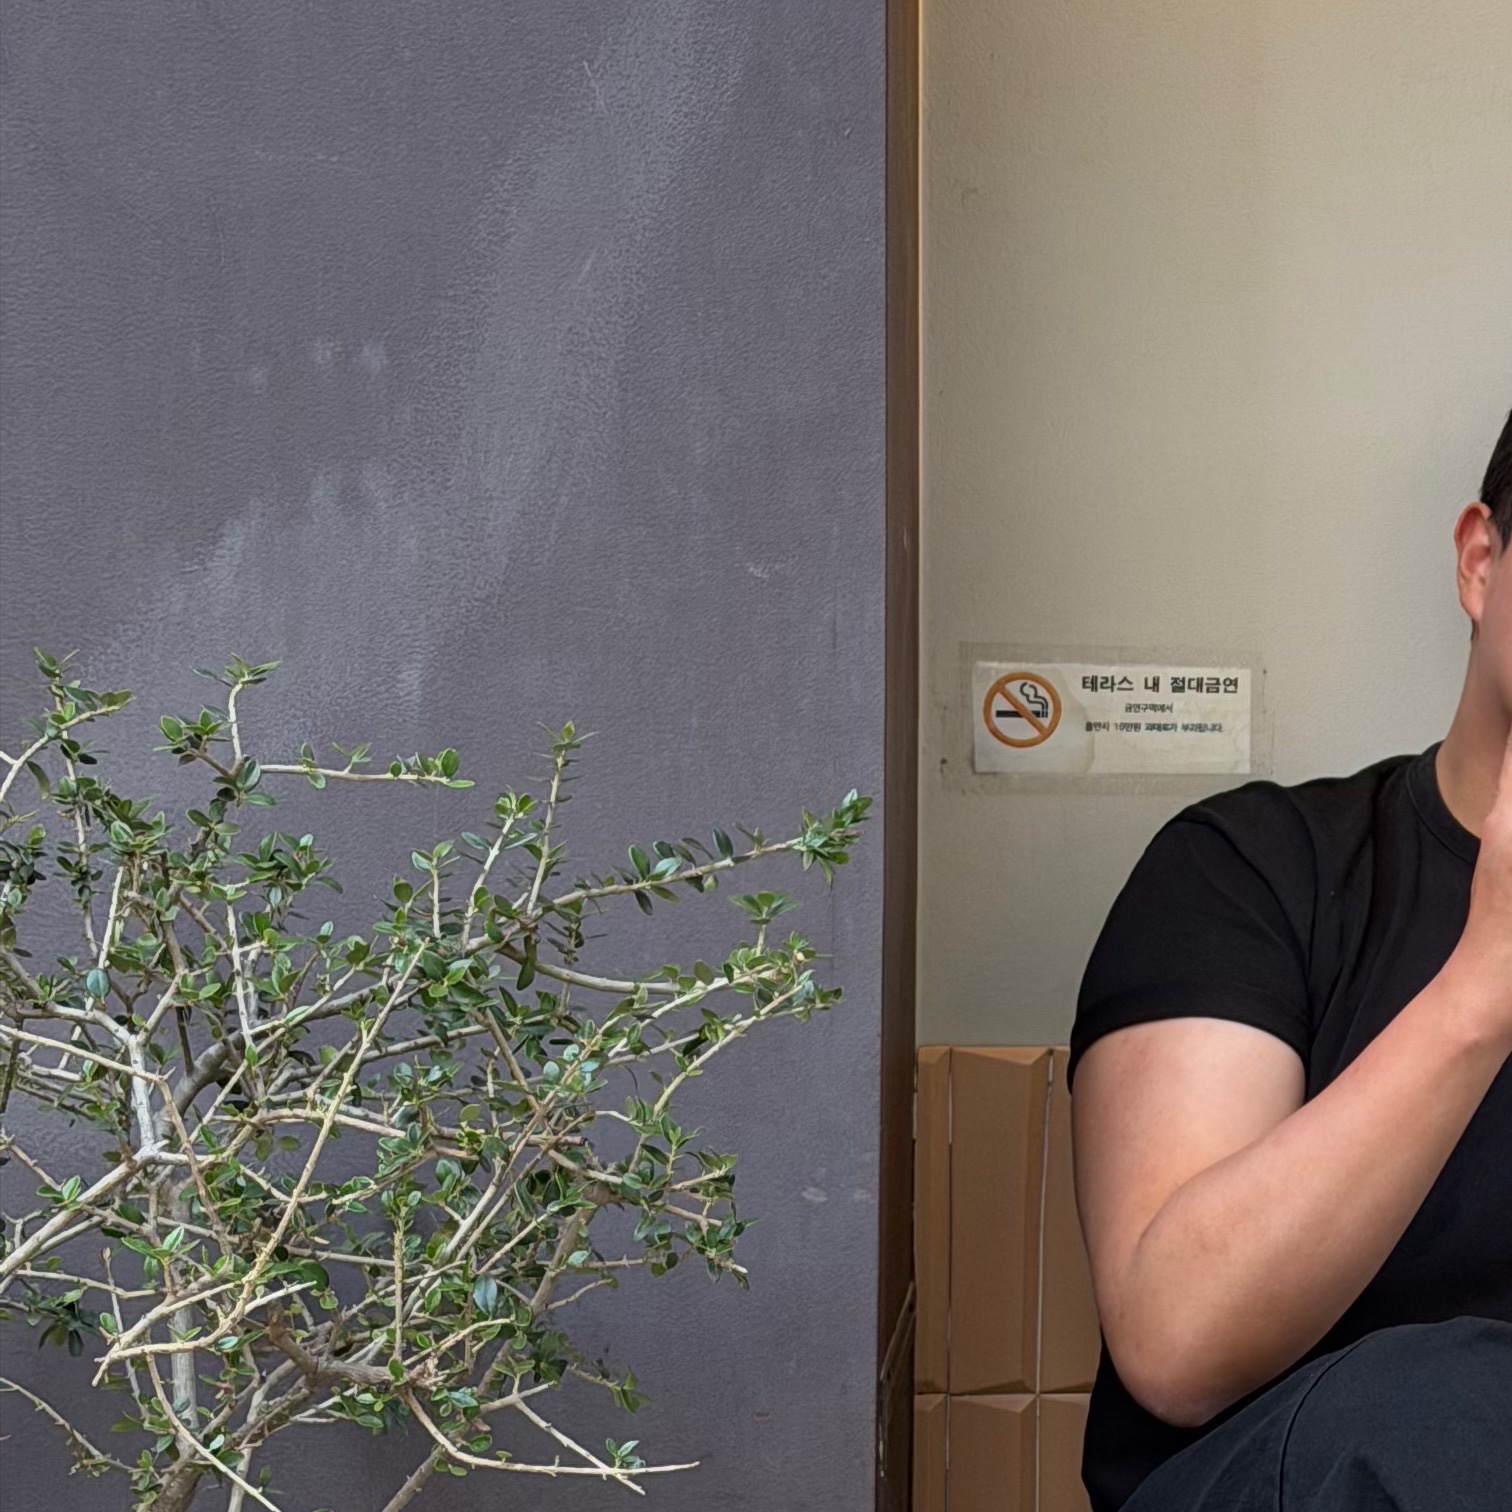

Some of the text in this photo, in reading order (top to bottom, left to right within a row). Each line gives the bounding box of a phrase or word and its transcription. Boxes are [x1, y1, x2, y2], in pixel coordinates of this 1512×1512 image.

[1081, 675, 1239, 694] 테라스 내 절대금연
